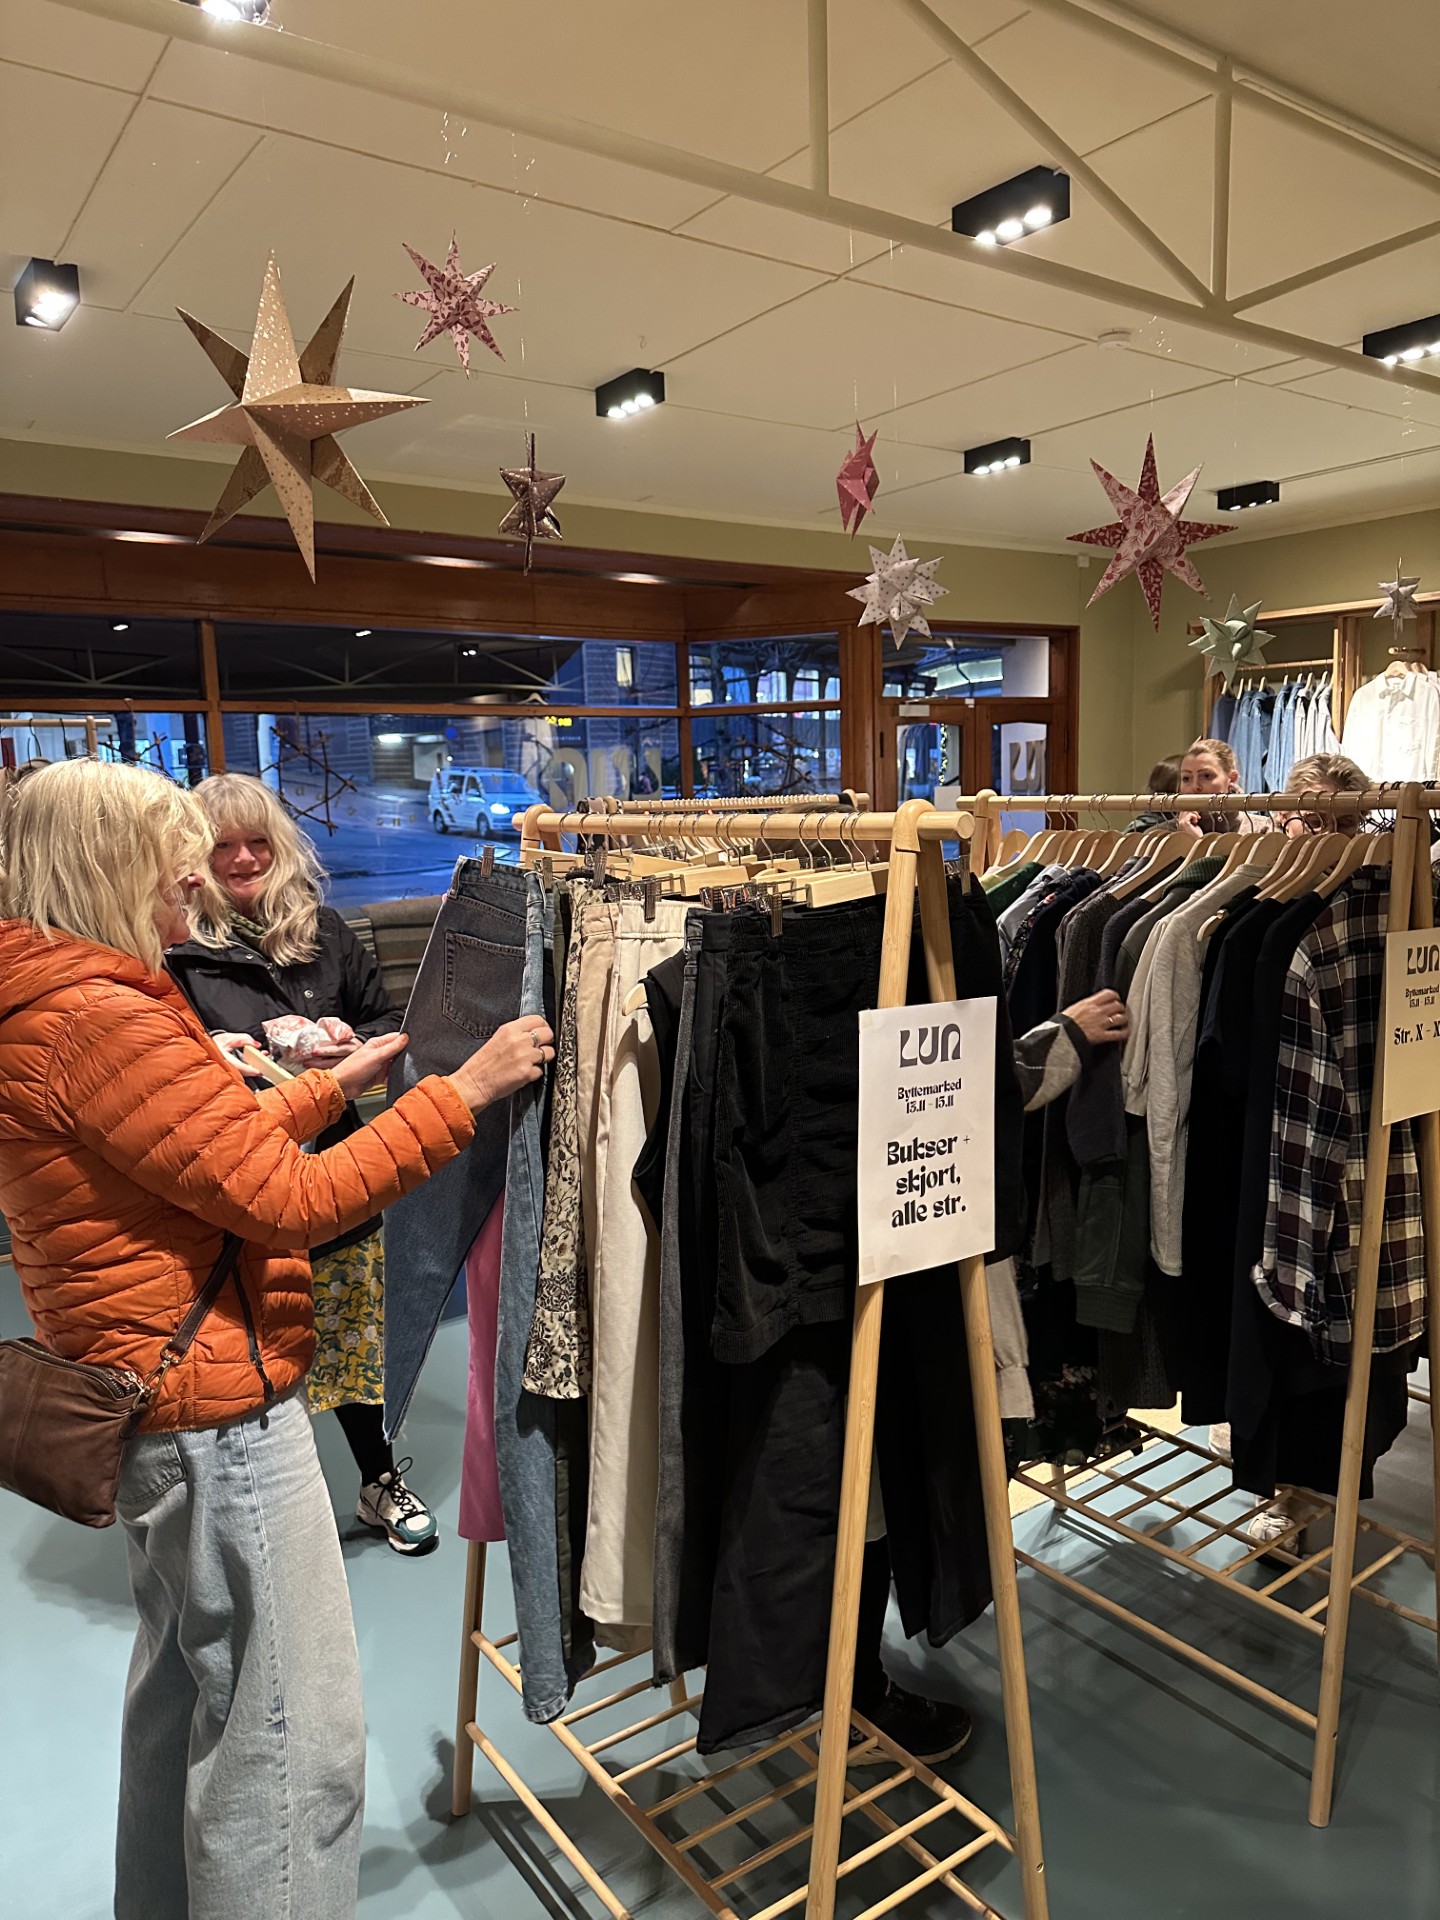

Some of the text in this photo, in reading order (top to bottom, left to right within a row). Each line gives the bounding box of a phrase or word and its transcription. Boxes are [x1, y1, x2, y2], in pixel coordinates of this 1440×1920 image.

[1407, 944, 1440, 975] LUN
[899, 1023, 961, 1068] LUN
[1394, 1027, 1413, 1045] Str.
[1415, 1023, 1424, 1041] X
[897, 1078, 962, 1102] Byttemarked
[935, 1094, 954, 1109] 15.11
[887, 1136, 958, 1166] Bukser
[891, 1194, 967, 1228] alle str.
